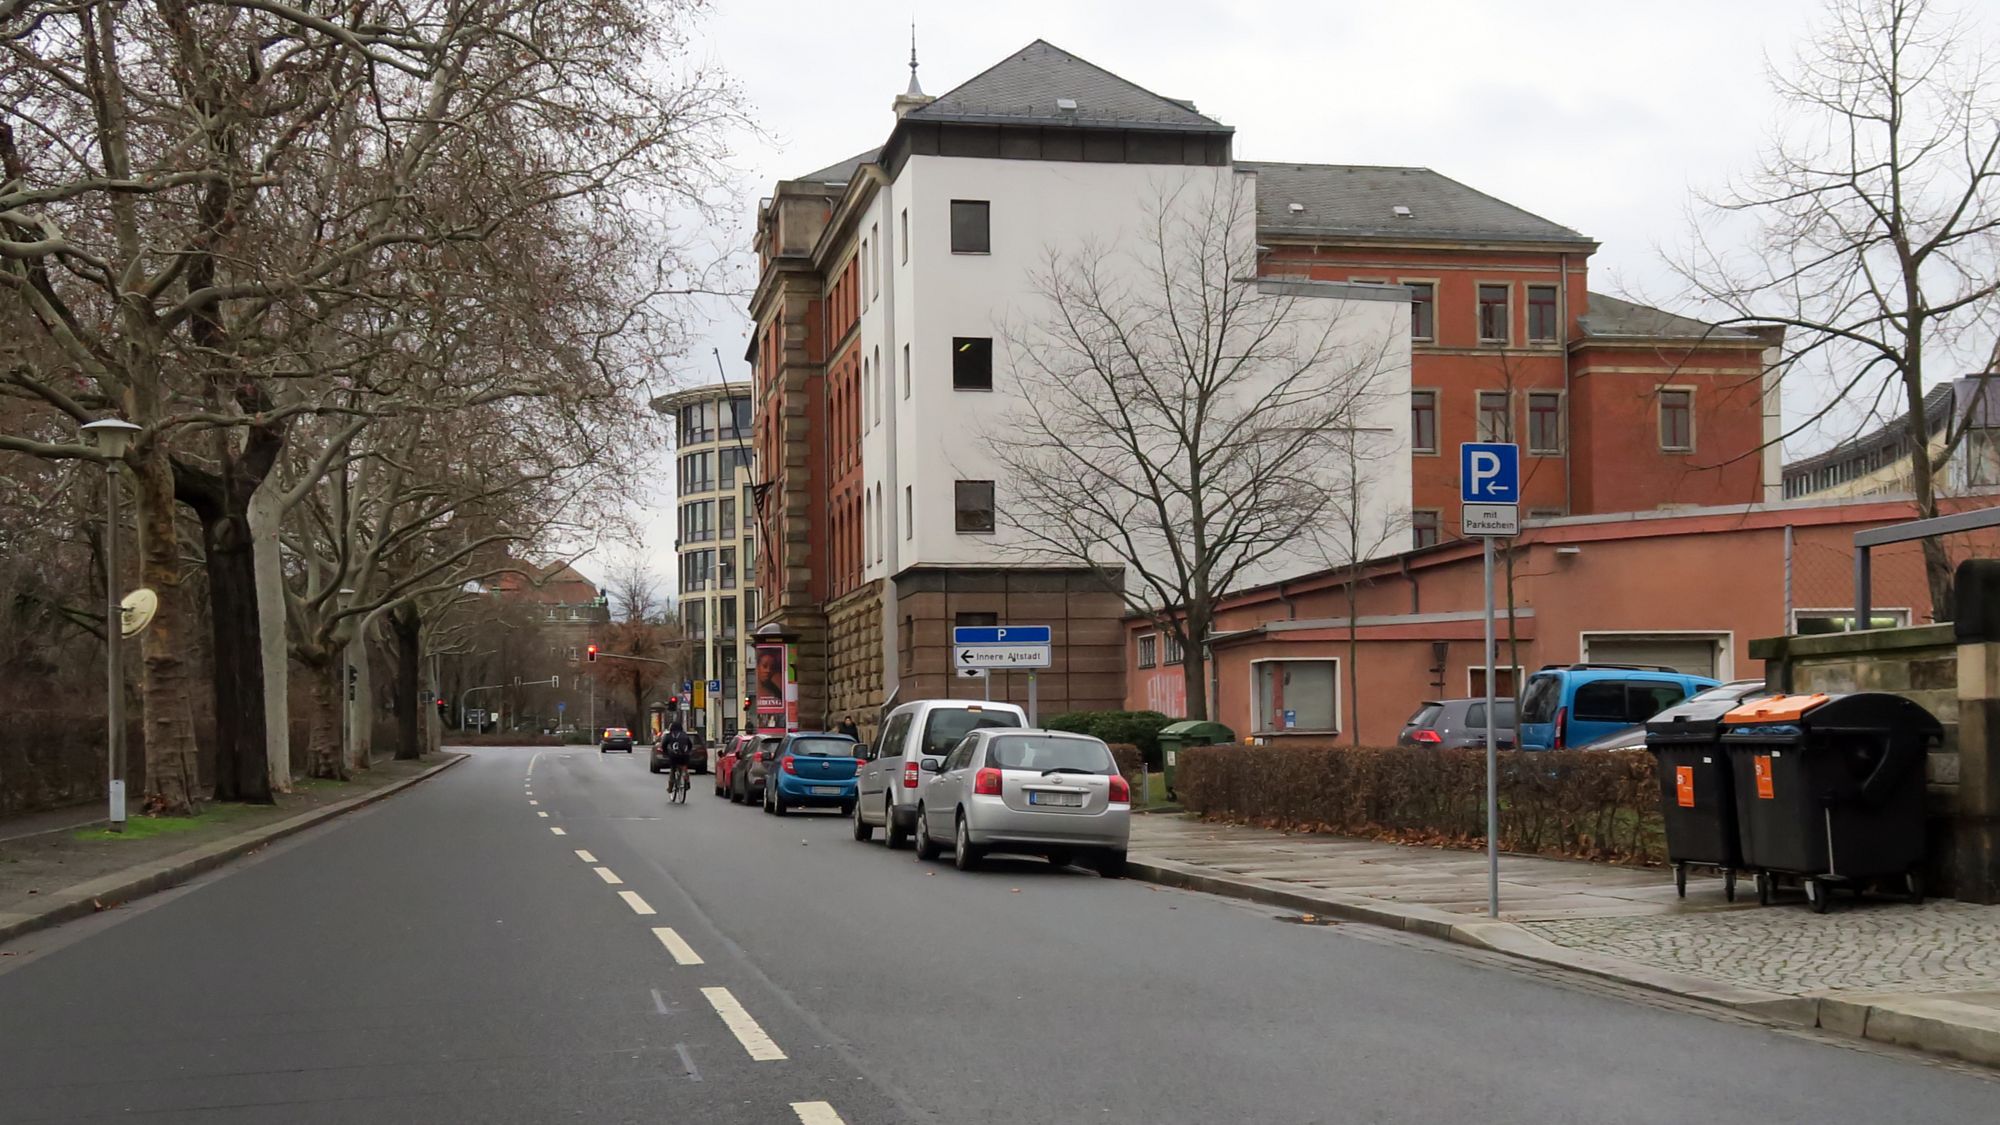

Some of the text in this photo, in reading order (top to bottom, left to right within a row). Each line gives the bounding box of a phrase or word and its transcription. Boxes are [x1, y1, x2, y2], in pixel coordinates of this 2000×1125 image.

[1471, 451, 1501, 495] P
[1466, 520, 1514, 529] Parkschein
[997, 629, 1007, 641] P
[1008, 652, 1040, 660] Altstadt
